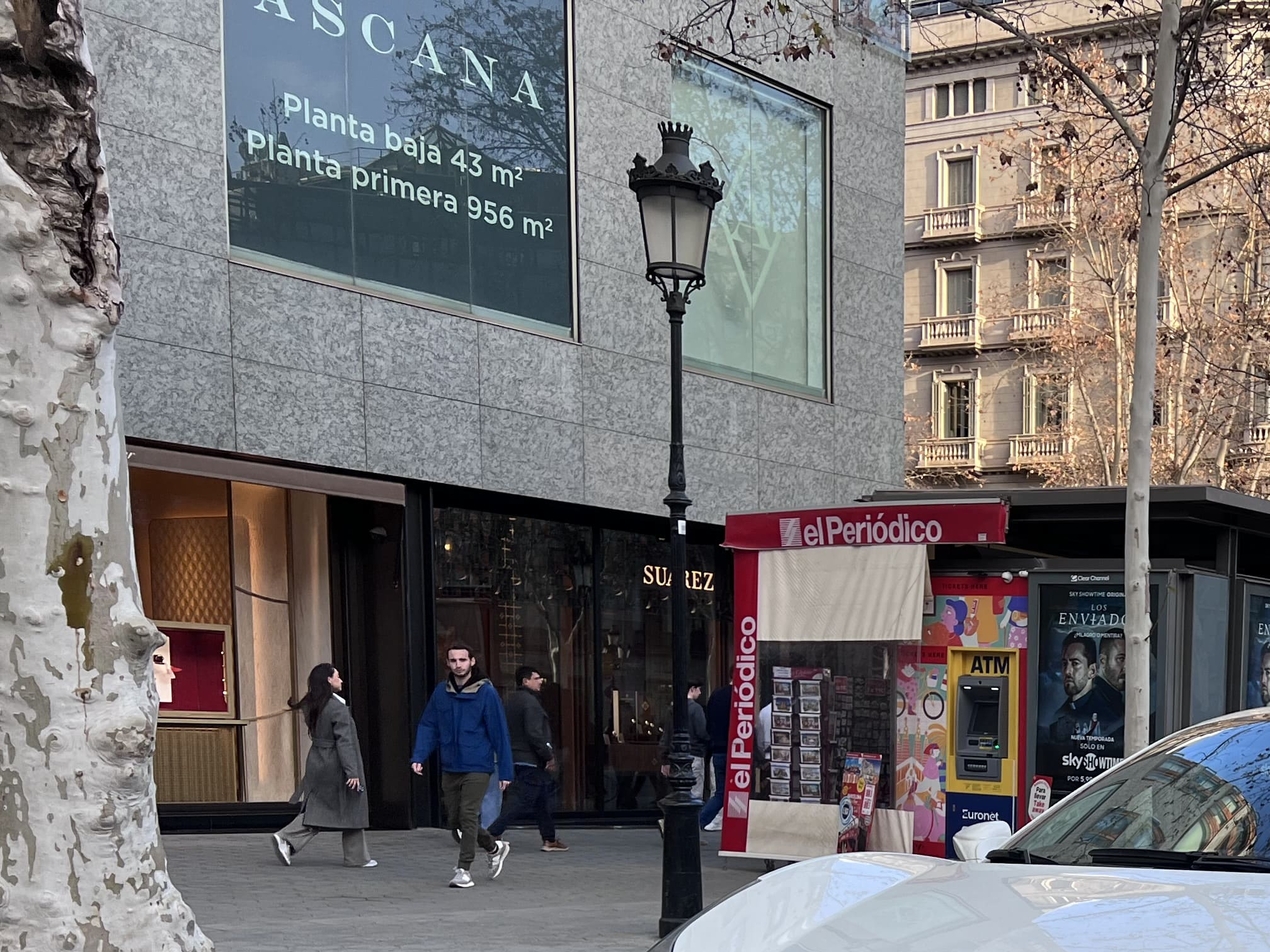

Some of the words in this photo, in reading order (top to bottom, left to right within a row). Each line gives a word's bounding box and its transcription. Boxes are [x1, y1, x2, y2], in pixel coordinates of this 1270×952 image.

[283, 92, 375, 144] Planta
[385, 124, 441, 165] baja
[450, 149, 483, 177] 43
[247, 129, 341, 180] Planta
[352, 165, 458, 214] primera
[467, 196, 514, 230] 956
[803, 516, 824, 546] el
[825, 513, 943, 545] Periódico
[970, 655, 1010, 674] ATM
[730, 616, 757, 759] Periódico
[730, 763, 750, 789] el
[962, 809, 1000, 821] Euronet
